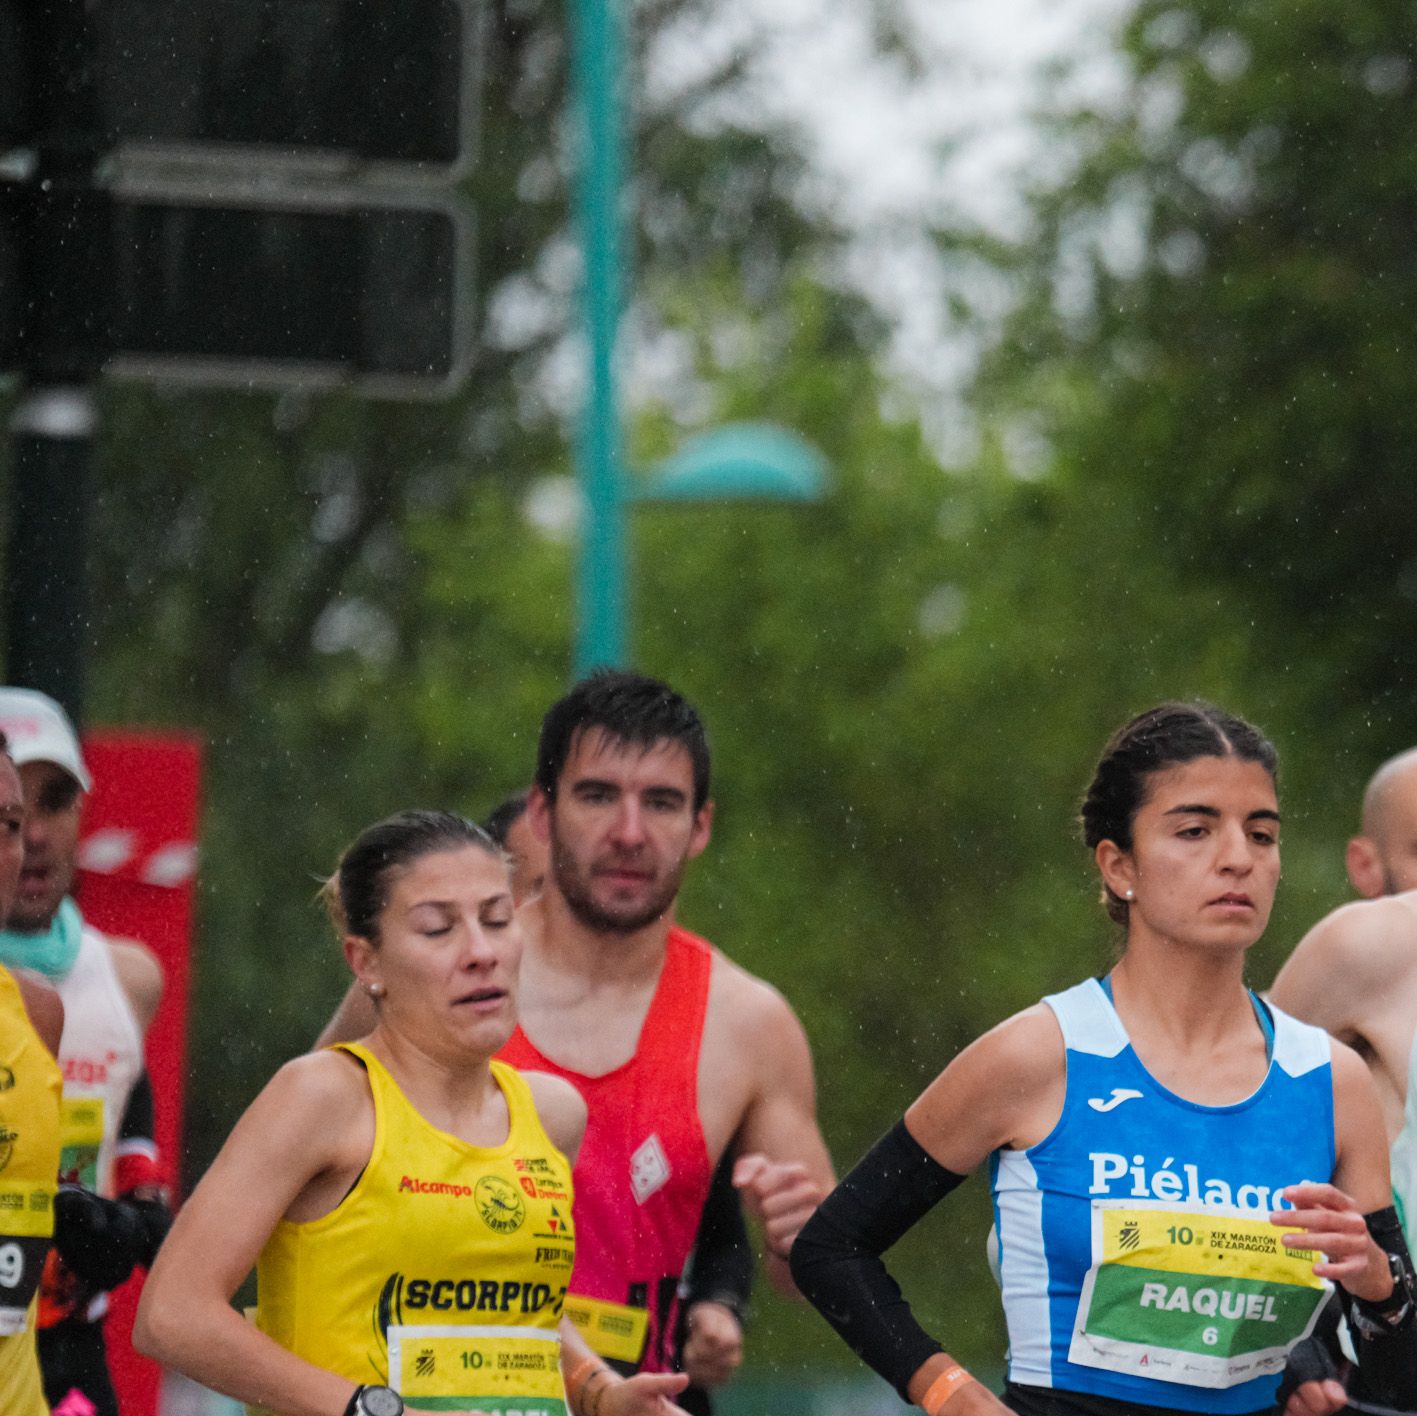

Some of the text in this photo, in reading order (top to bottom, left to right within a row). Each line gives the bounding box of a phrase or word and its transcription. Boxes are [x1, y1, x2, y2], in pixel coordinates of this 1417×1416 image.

[399, 1175, 473, 1198] Alcampo
[1167, 1226, 1193, 1245] 10
[1211, 1231, 1277, 1246] XIX MARATÓN
[1210, 1240, 1277, 1254] DE ZARAGOZA
[1139, 1282, 1278, 1323] RAQUEL
[1202, 1327, 1218, 1345] 6
[460, 1351, 483, 1369] 10
